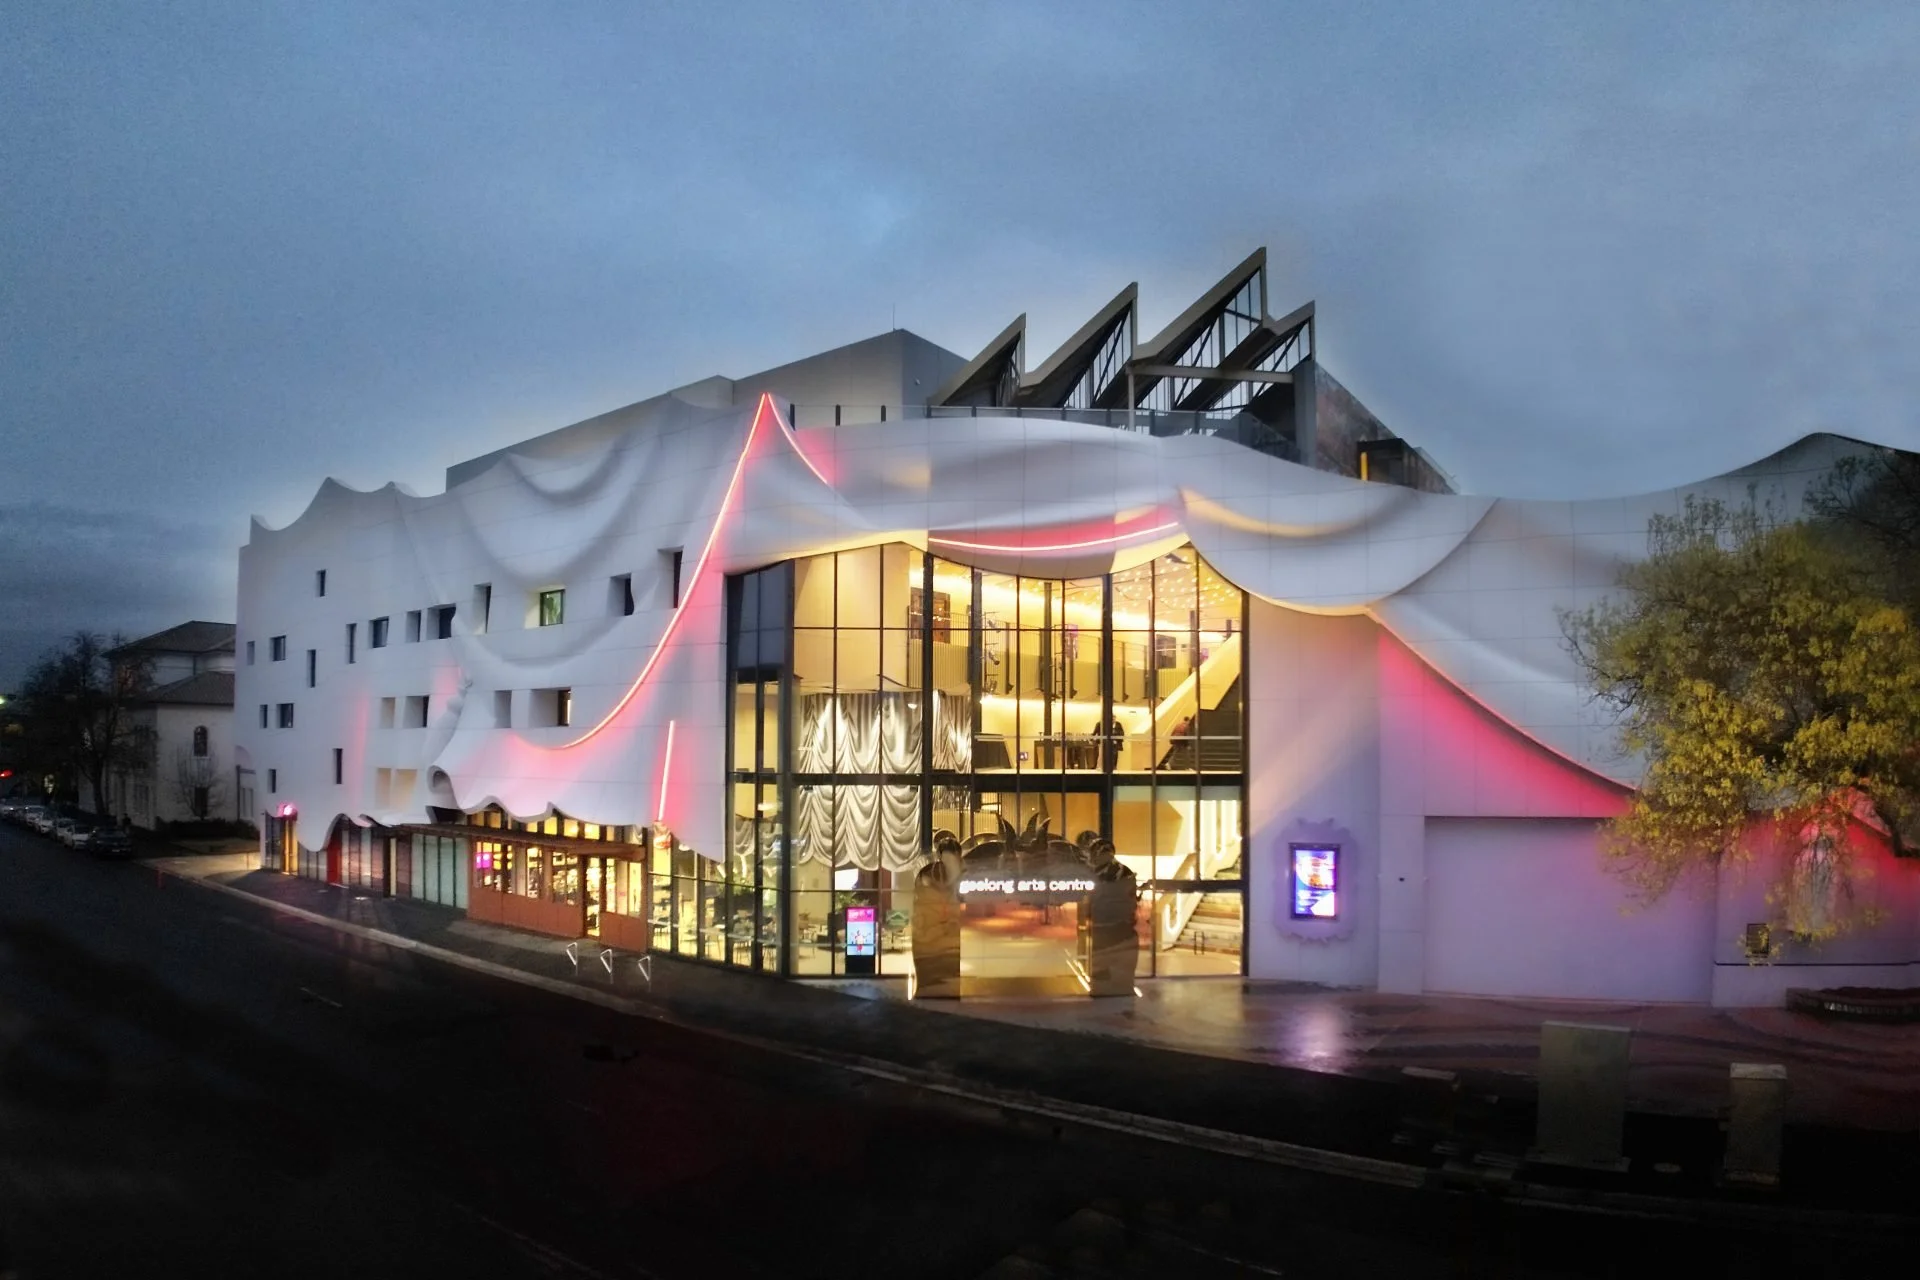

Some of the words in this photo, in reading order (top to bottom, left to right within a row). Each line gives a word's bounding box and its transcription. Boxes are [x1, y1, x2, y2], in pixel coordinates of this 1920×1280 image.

[959, 878, 1014, 894] geelong
[1017, 878, 1046, 892] arts
[1049, 878, 1095, 892] centre
